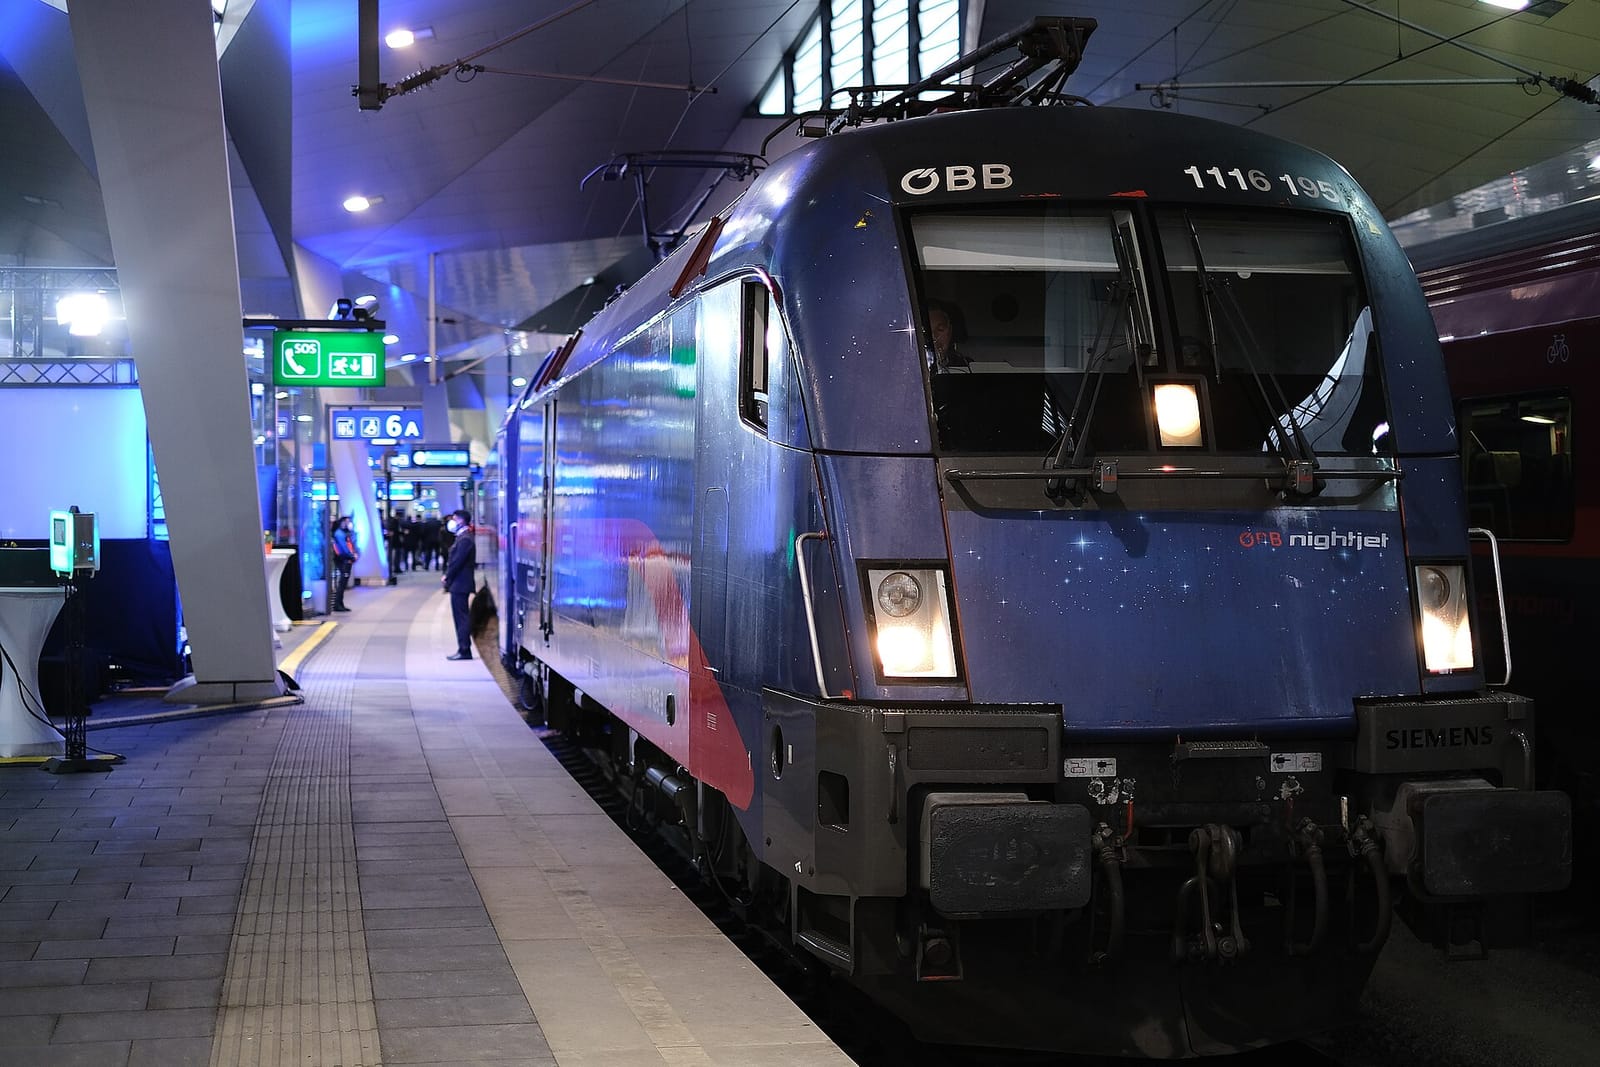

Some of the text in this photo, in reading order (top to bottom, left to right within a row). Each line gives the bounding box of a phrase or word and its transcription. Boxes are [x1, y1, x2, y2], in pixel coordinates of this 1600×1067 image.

[900, 163, 1013, 195] ÖBB
[1183, 165, 1340, 203] 1116 195
[294, 343, 317, 354] SOS
[1289, 531, 1389, 550] nightjet
[1386, 726, 1494, 750] SIEMENS
